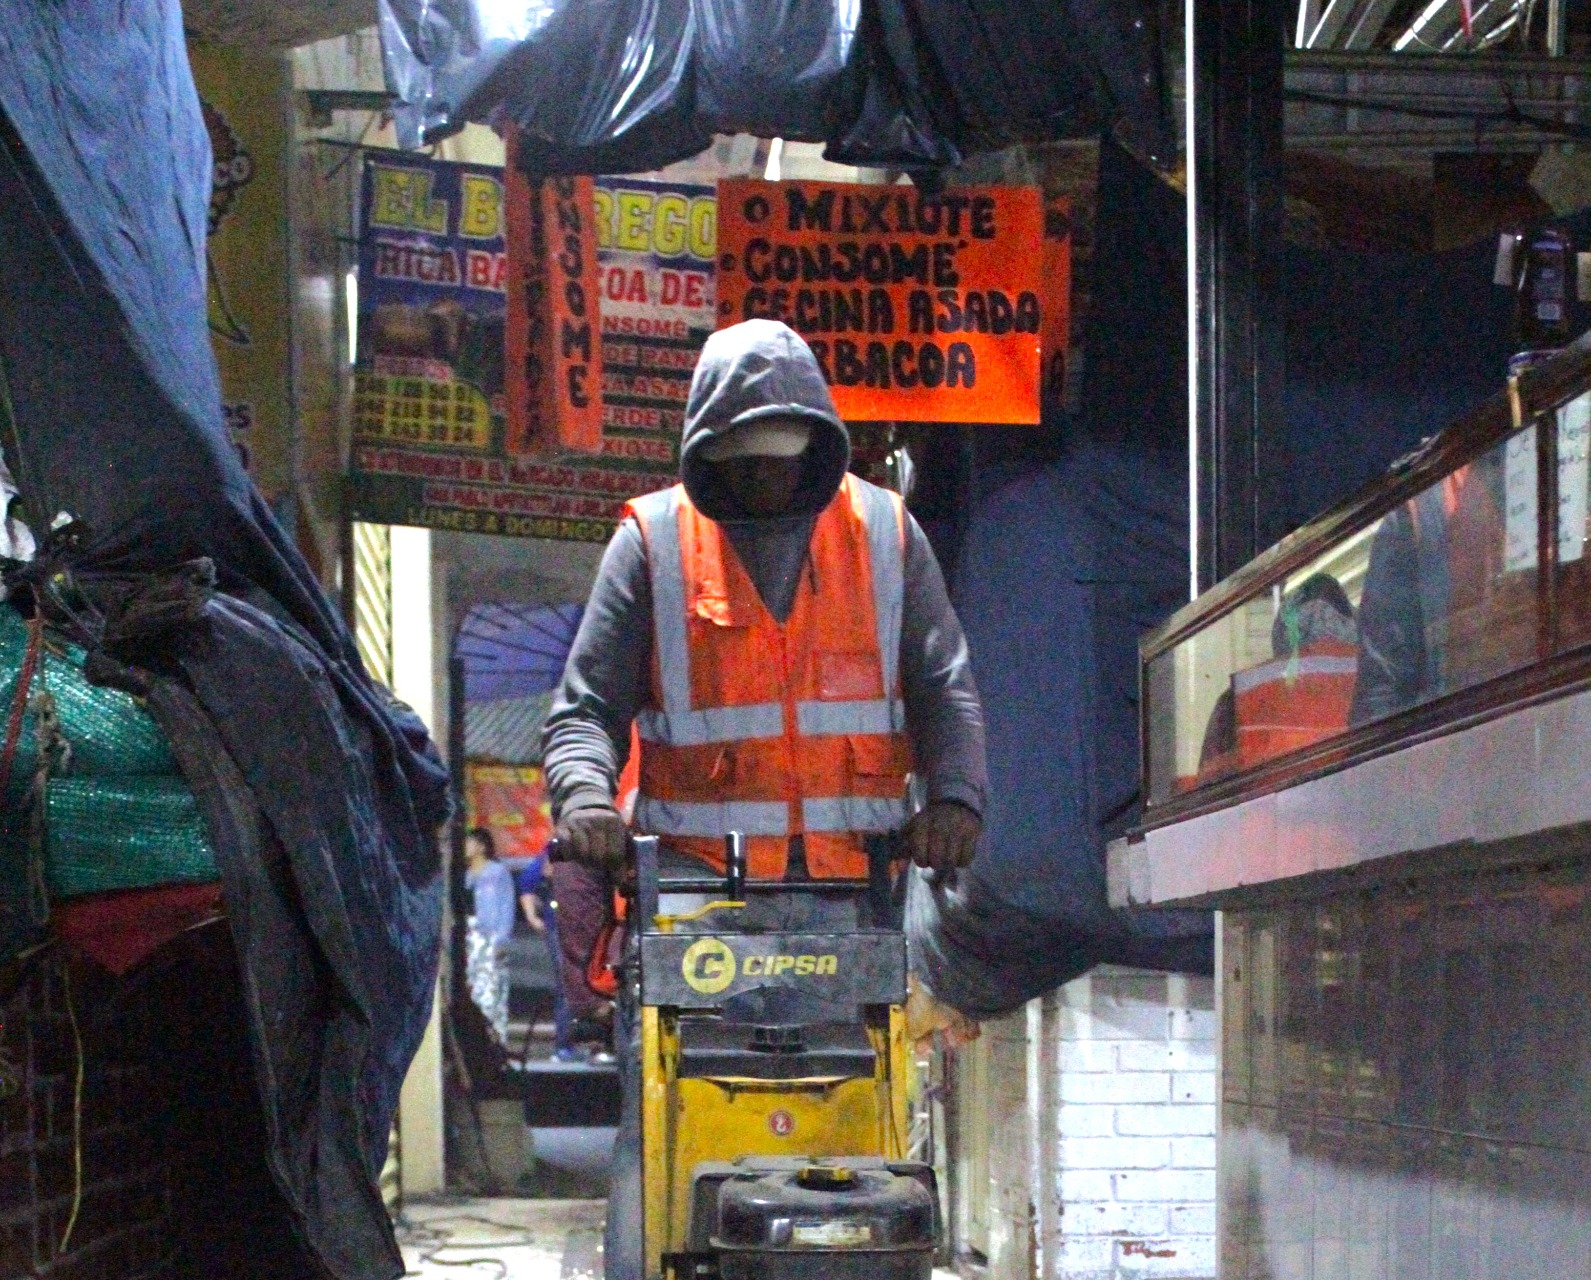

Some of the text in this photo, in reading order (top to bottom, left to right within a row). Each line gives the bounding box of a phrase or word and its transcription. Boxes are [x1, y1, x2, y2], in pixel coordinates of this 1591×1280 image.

[372, 168, 717, 259] EL BREGO
[379, 243, 456, 283] RICA
[660, 270, 705, 308] DE
[909, 289, 1040, 335] ASADA
[607, 347, 634, 365] DE
[408, 506, 605, 542] LUNES A DOMINGO
[742, 955, 838, 976] CIPSA
